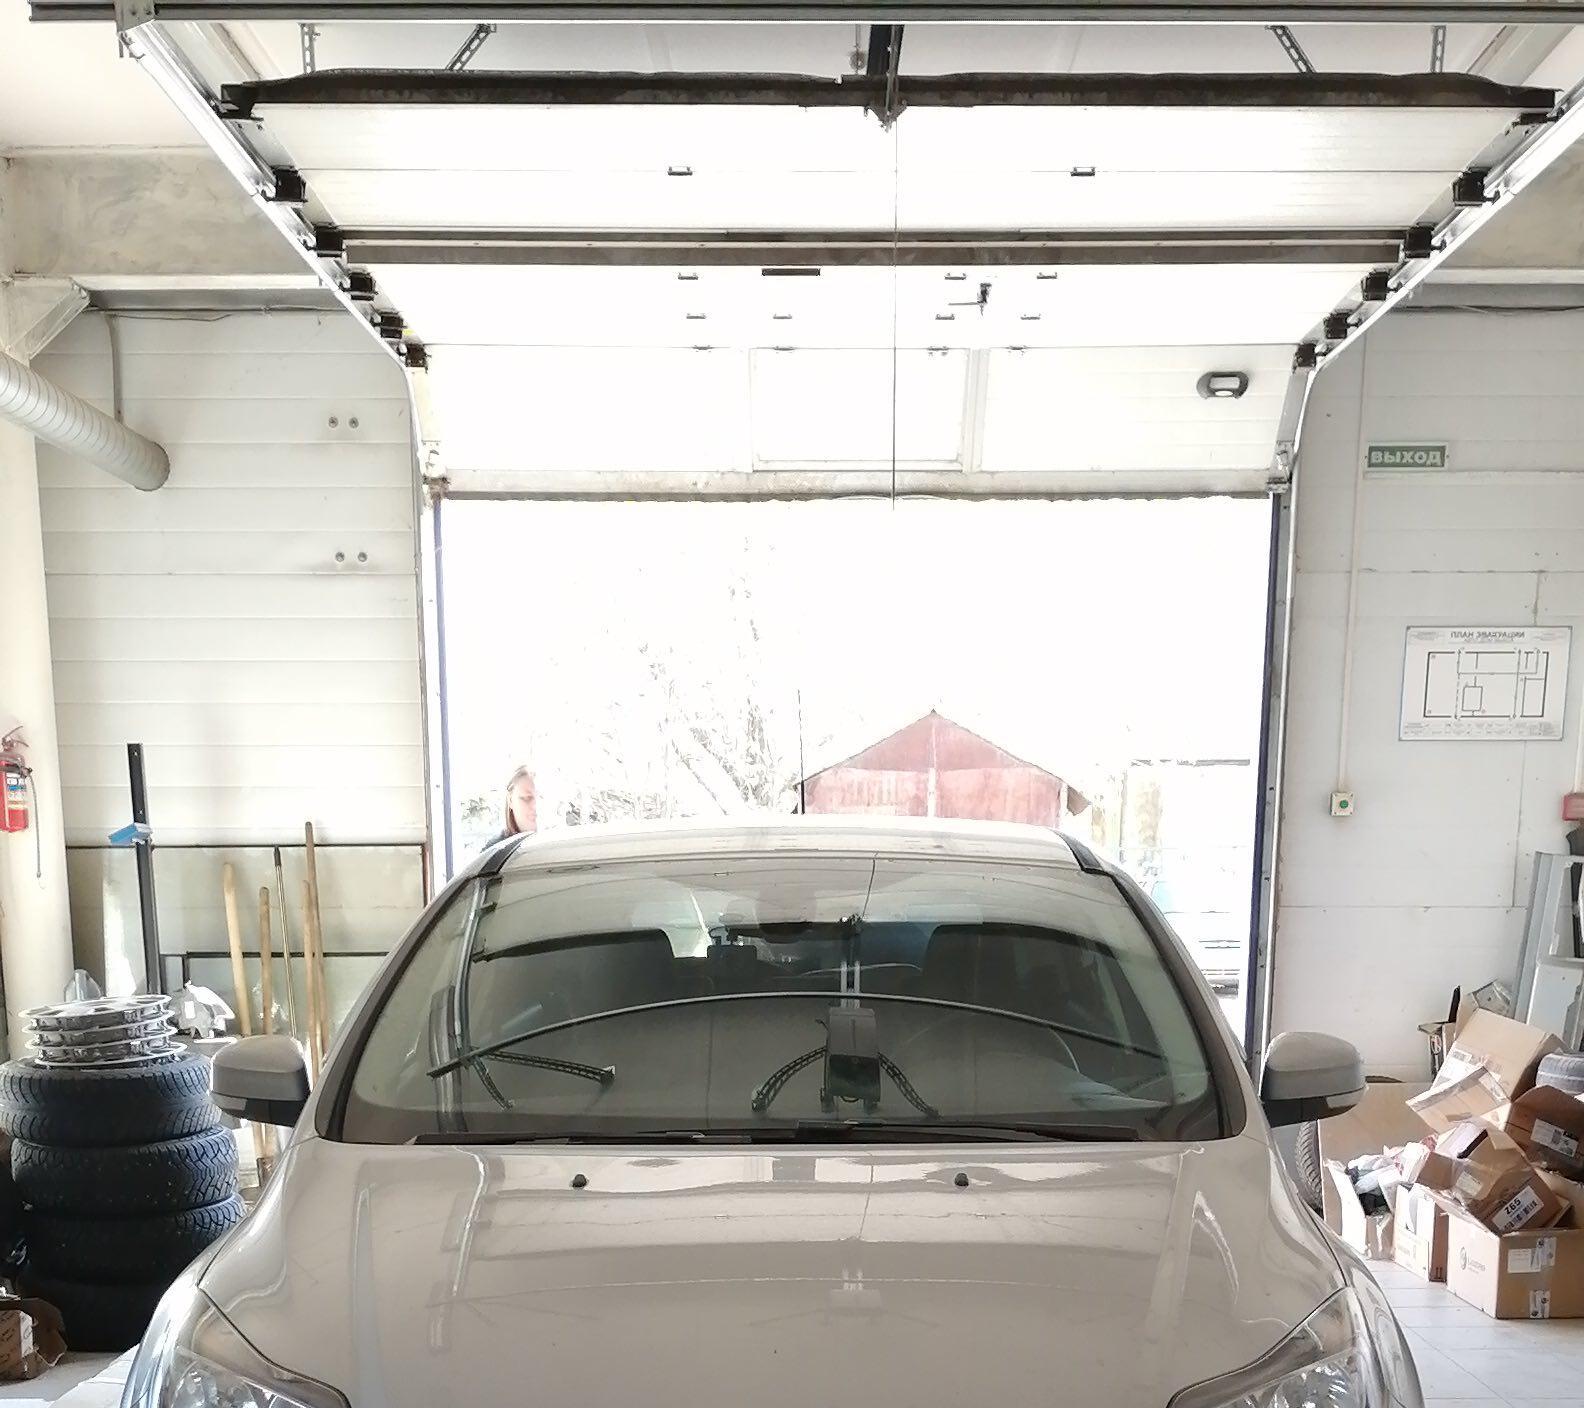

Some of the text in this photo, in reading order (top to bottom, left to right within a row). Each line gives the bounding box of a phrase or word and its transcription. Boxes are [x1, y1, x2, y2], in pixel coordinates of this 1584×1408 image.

[1371, 451, 1442, 466] ВЫХОД
[1450, 631, 1474, 639] ПЛАН
[1476, 631, 1525, 640] ЭВАКУАЦИИ
